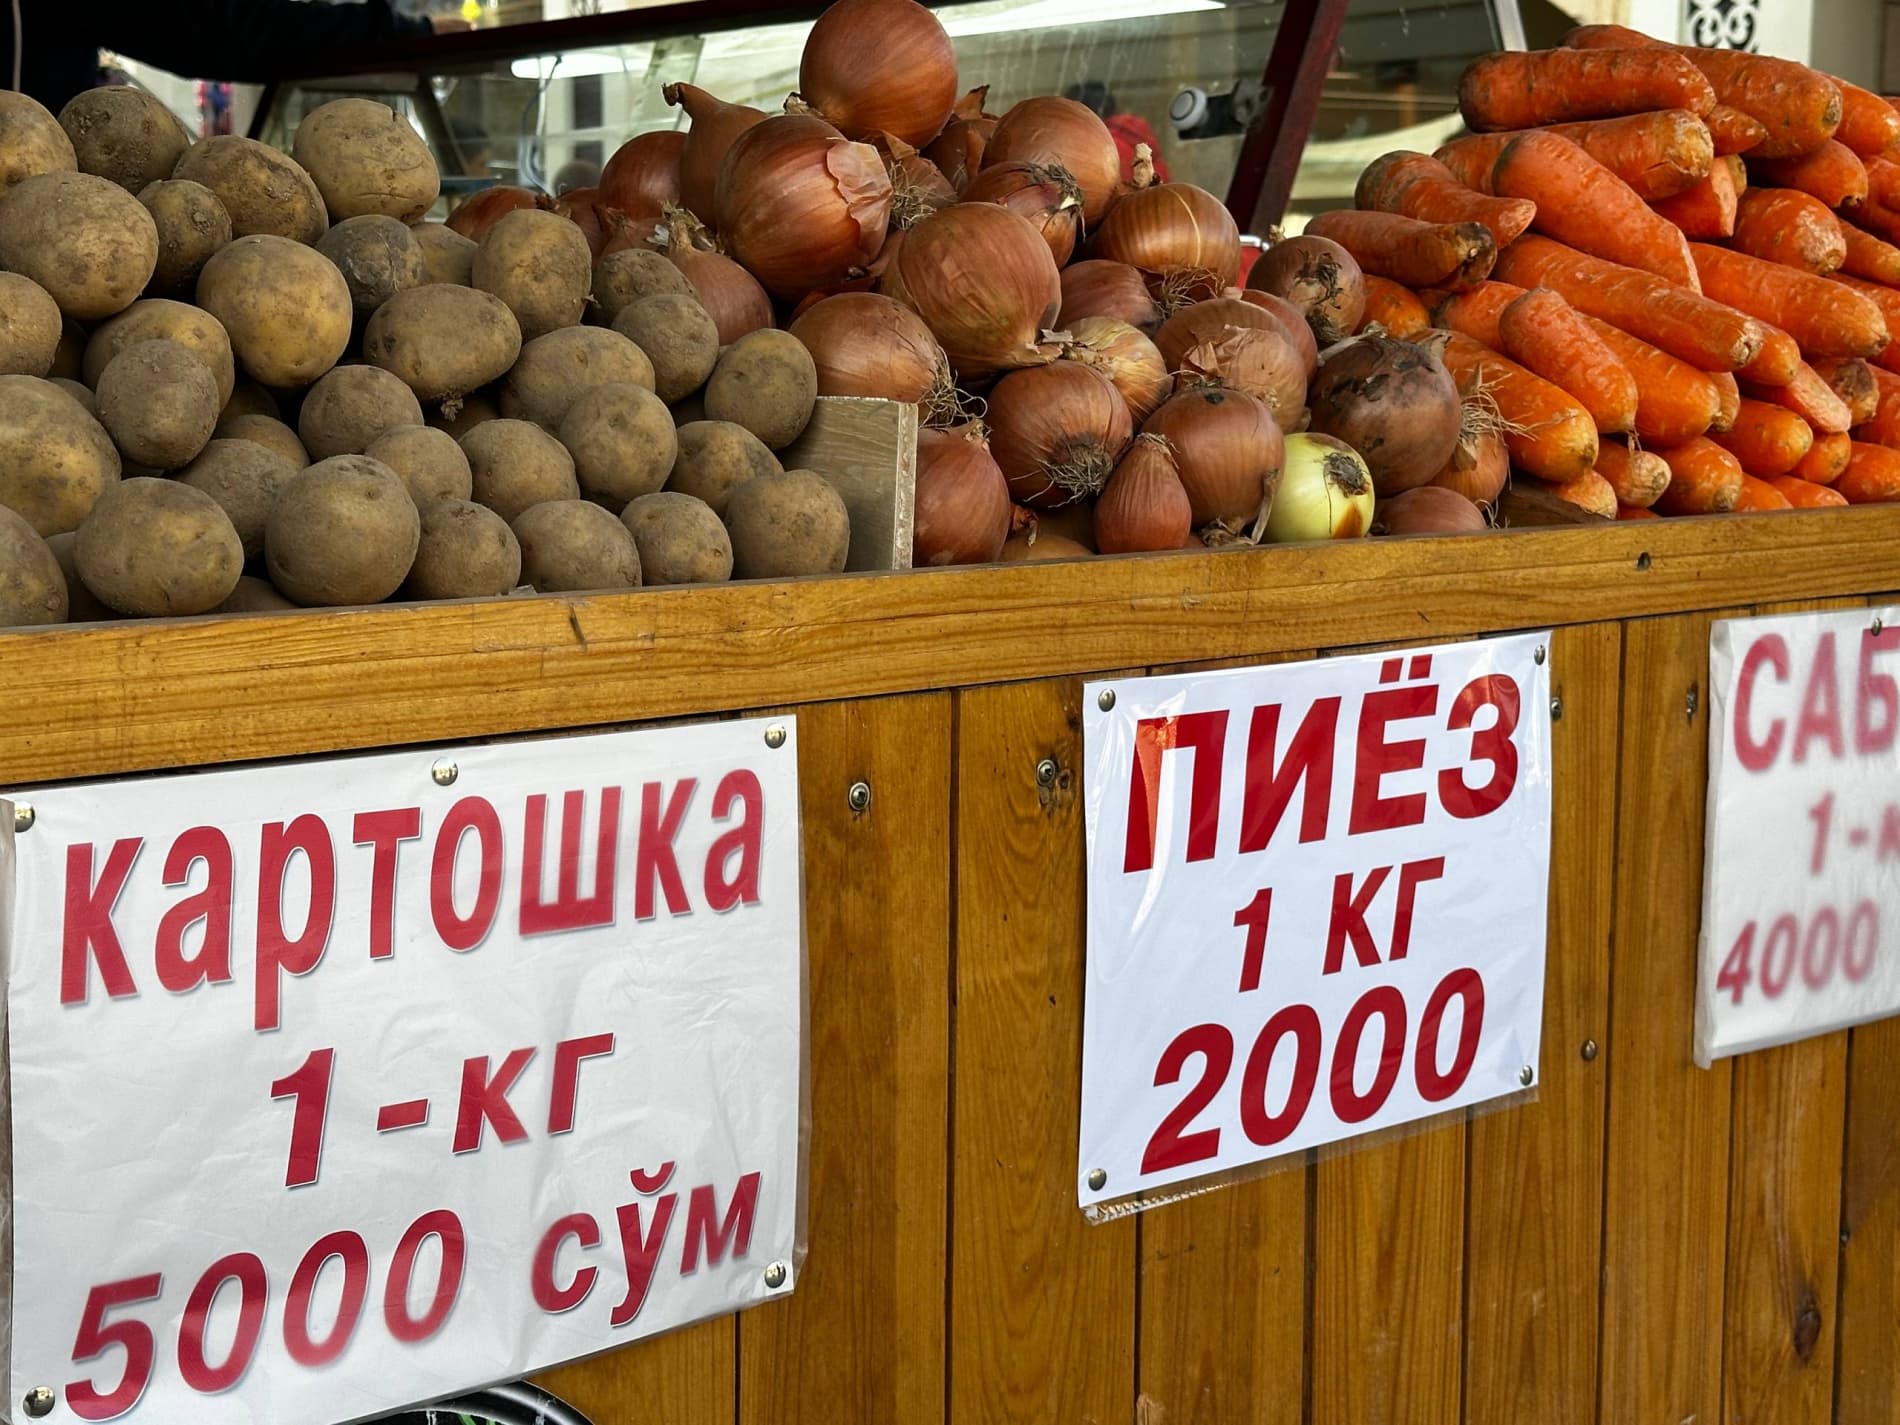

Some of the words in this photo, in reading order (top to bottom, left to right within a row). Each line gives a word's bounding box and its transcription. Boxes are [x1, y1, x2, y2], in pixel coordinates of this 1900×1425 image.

[1123, 654, 1521, 874] ПИЁЗ
[60, 768, 766, 1032] картошка
[1233, 887, 1272, 993] 1
[1716, 900, 1879, 1005] 4000
[1139, 967, 1485, 1176] 2000
[63, 1209, 467, 1422] 5000
[530, 1162, 762, 1327] сўм
